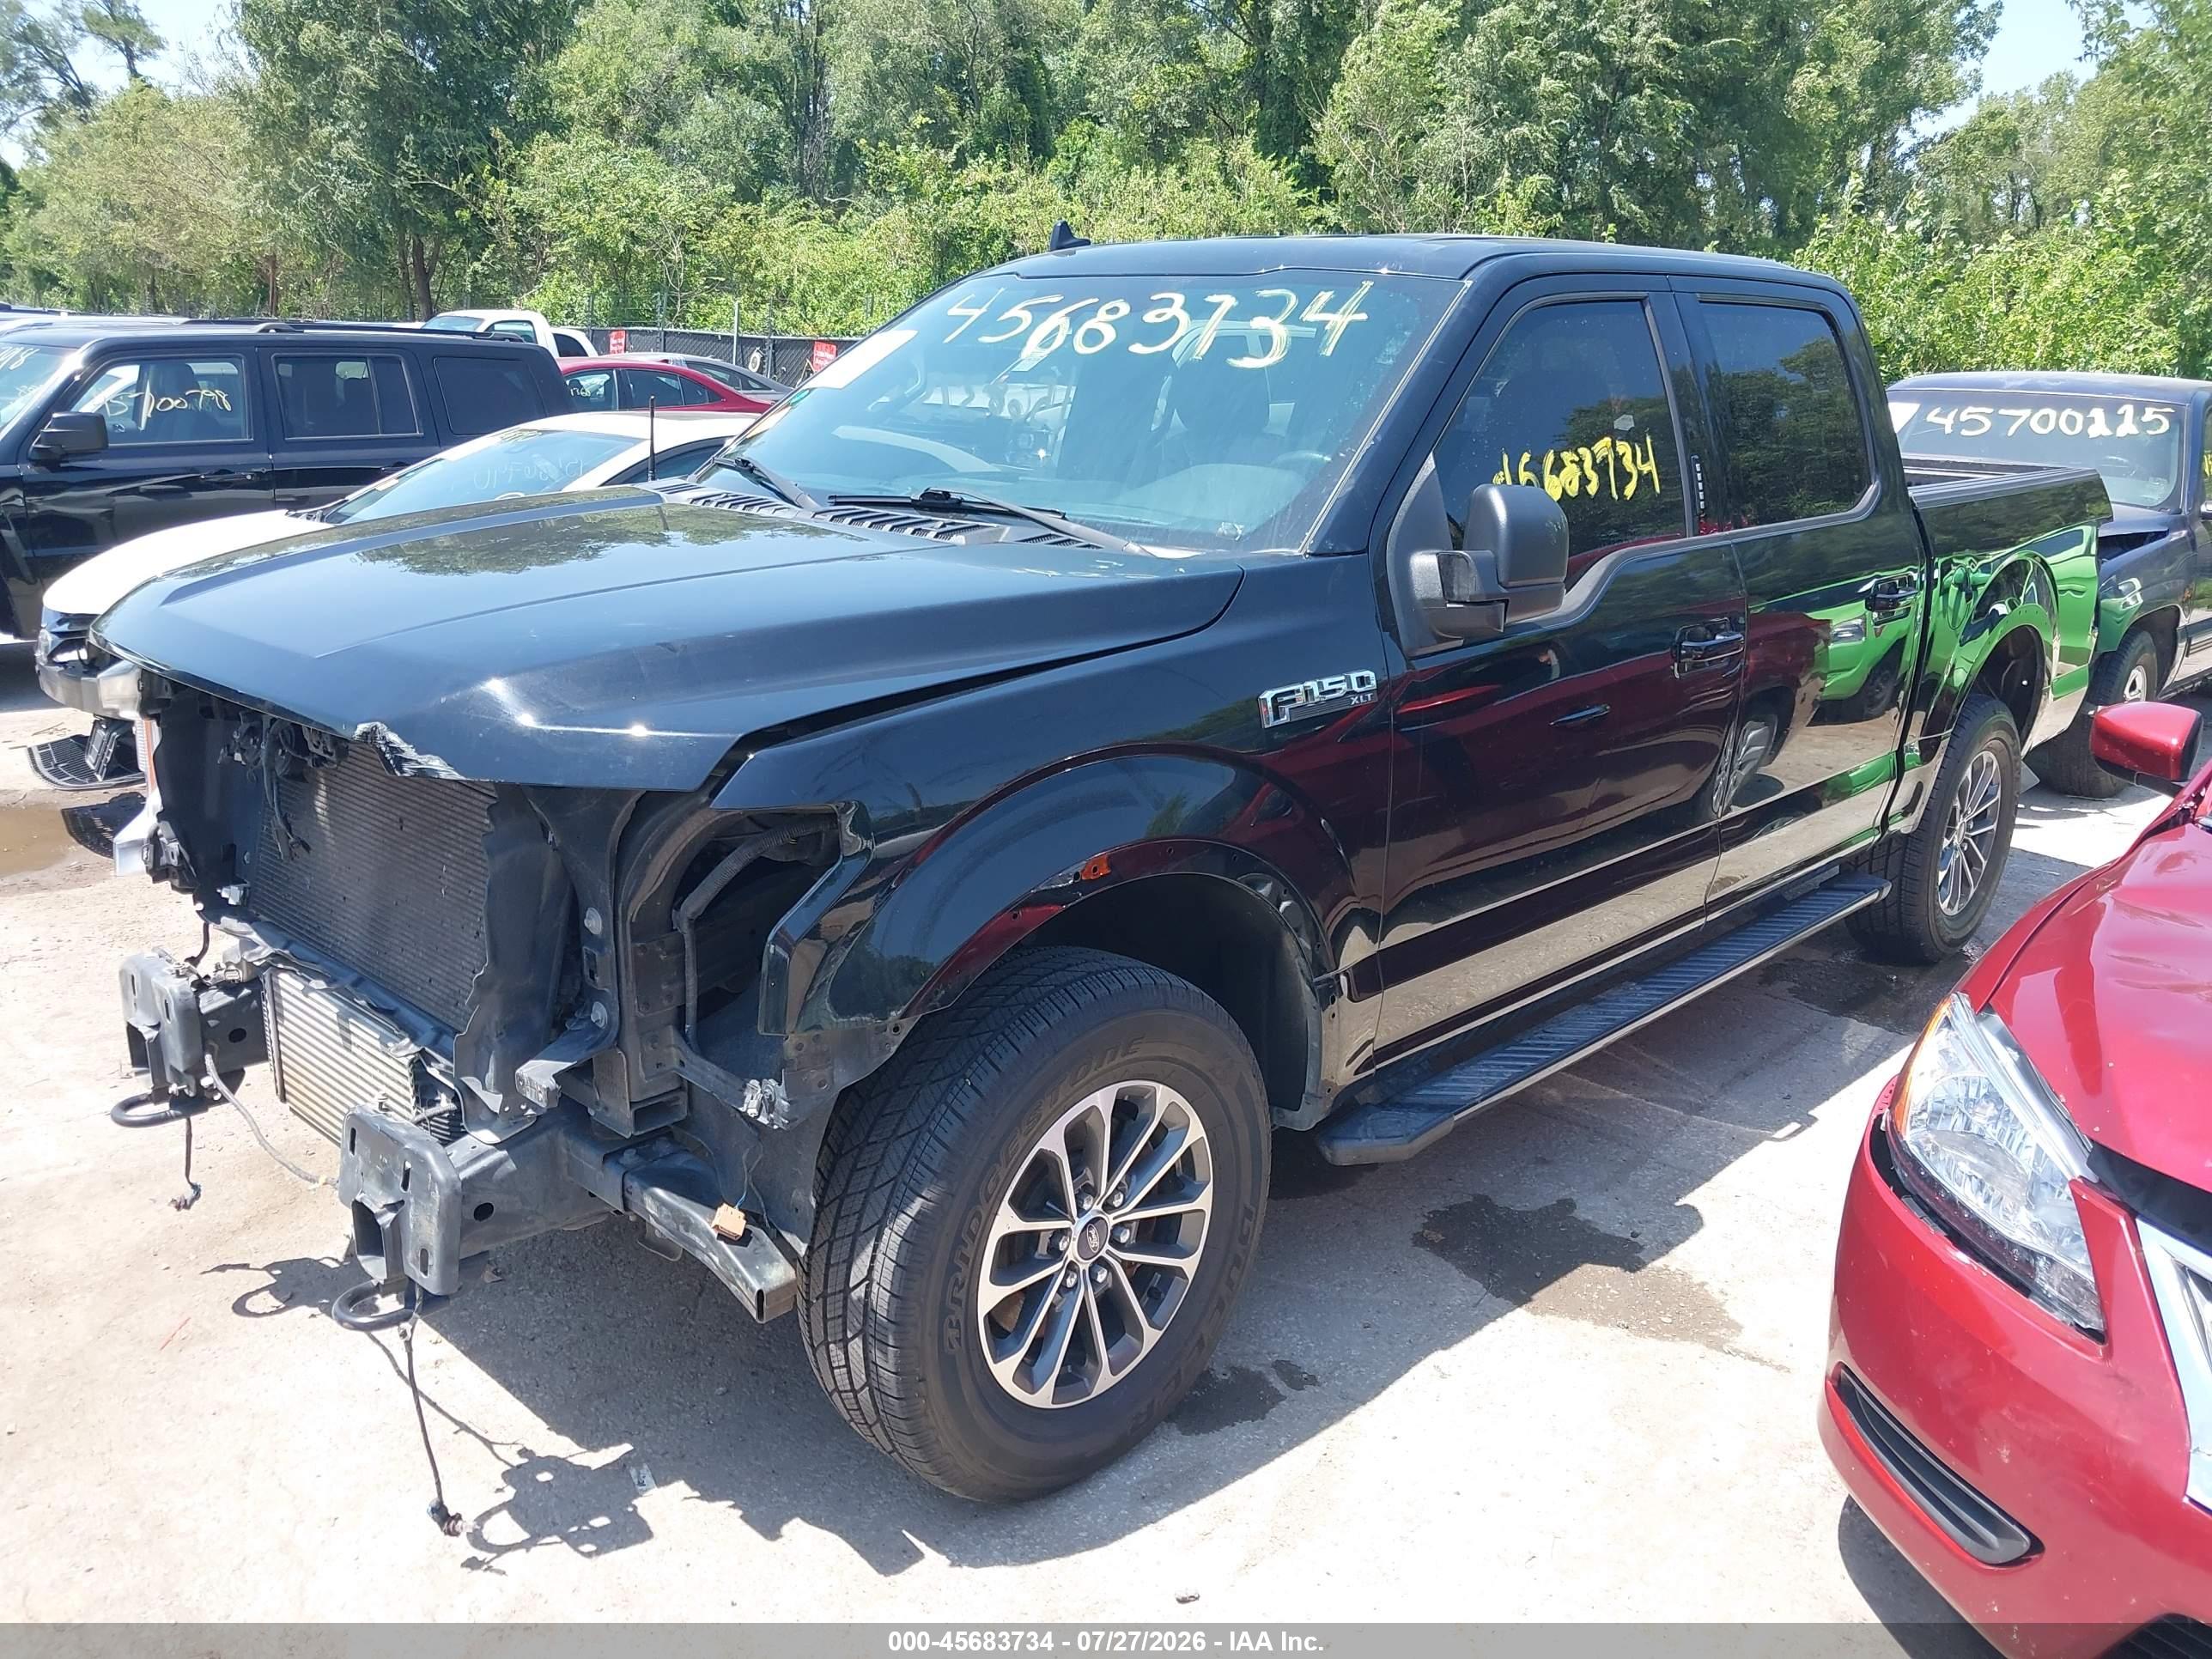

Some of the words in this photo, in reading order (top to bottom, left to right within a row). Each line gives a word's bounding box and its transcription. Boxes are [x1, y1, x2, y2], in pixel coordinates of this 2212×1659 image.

[944, 279, 1374, 369] 45683734
[1925, 403, 2177, 439] 45700115
[1257, 669, 1378, 730] F150
[1348, 692, 1375, 708] XLT
[945, 1036, 1146, 1354] BRIDGESTONE
